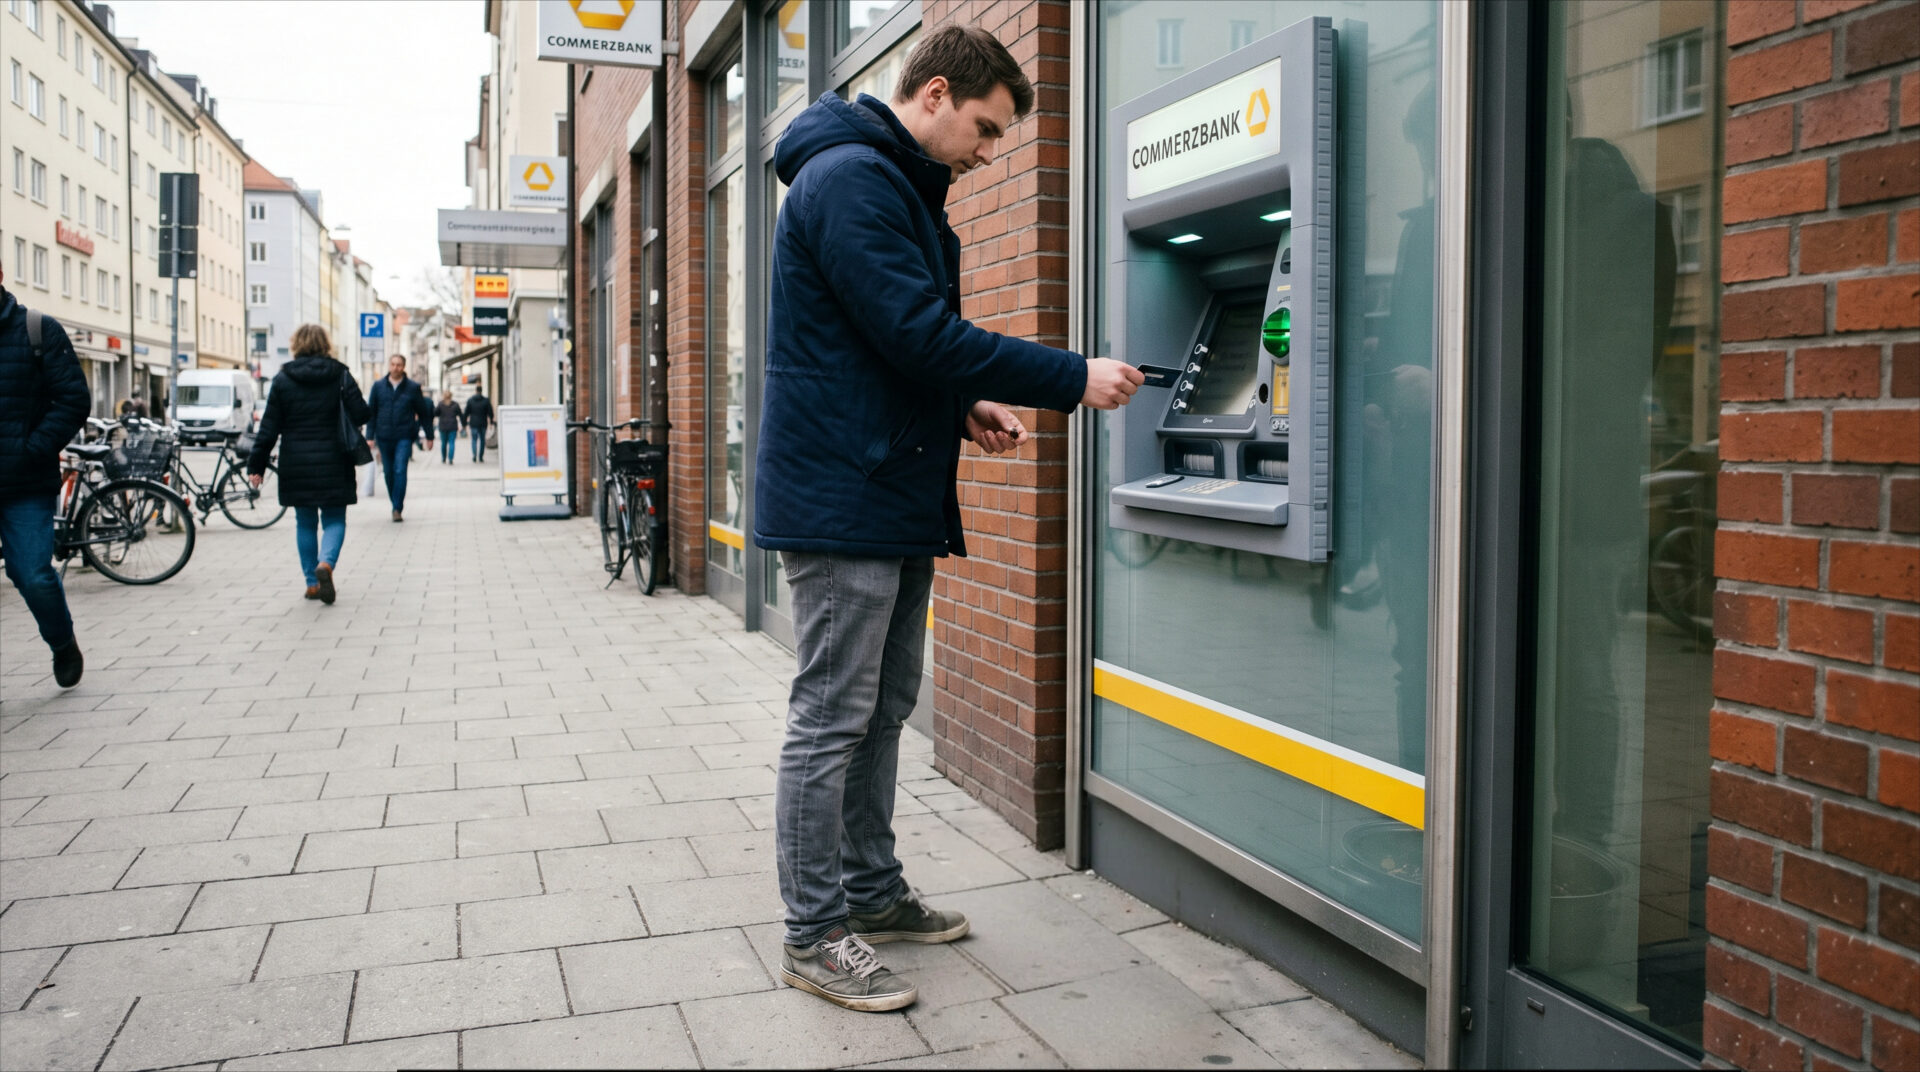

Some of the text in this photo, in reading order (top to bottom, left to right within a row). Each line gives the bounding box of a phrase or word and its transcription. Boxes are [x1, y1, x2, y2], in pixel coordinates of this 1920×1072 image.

[547, 36, 653, 54] COMMERZBANK
[1132, 110, 1241, 170] COMMERZBANK
[364, 315, 379, 335] P
